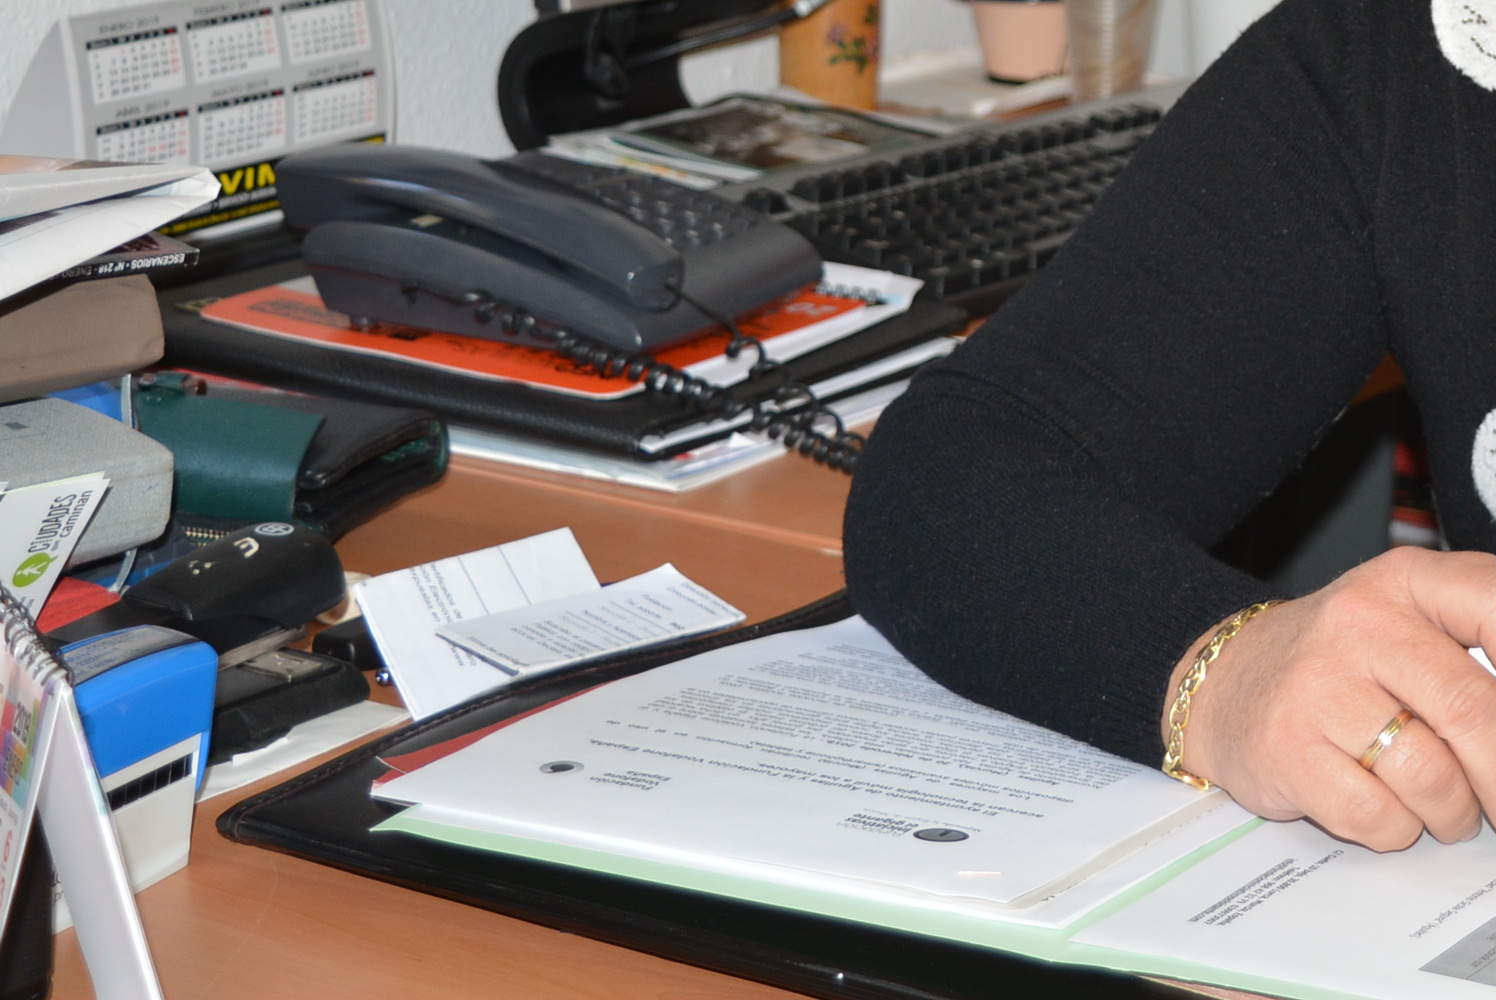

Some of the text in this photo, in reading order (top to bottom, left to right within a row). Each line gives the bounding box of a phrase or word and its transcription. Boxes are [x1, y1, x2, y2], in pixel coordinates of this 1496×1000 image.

[130, 253, 186, 270] ESCENARIOS
[57, 488, 95, 539] caminan
[429, 562, 456, 607] ertificados
[638, 748, 709, 763] Vodafone
[704, 760, 782, 776] Fundación
[753, 762, 820, 776] mayores.
[851, 780, 895, 790] móvil
[945, 781, 1003, 793] mayores
[881, 792, 983, 812] ayuntamiento
[891, 787, 972, 804] tecnología
[853, 812, 905, 826] gigante
[984, 805, 1047, 817] acercan
[844, 817, 912, 833] Iniciativas
